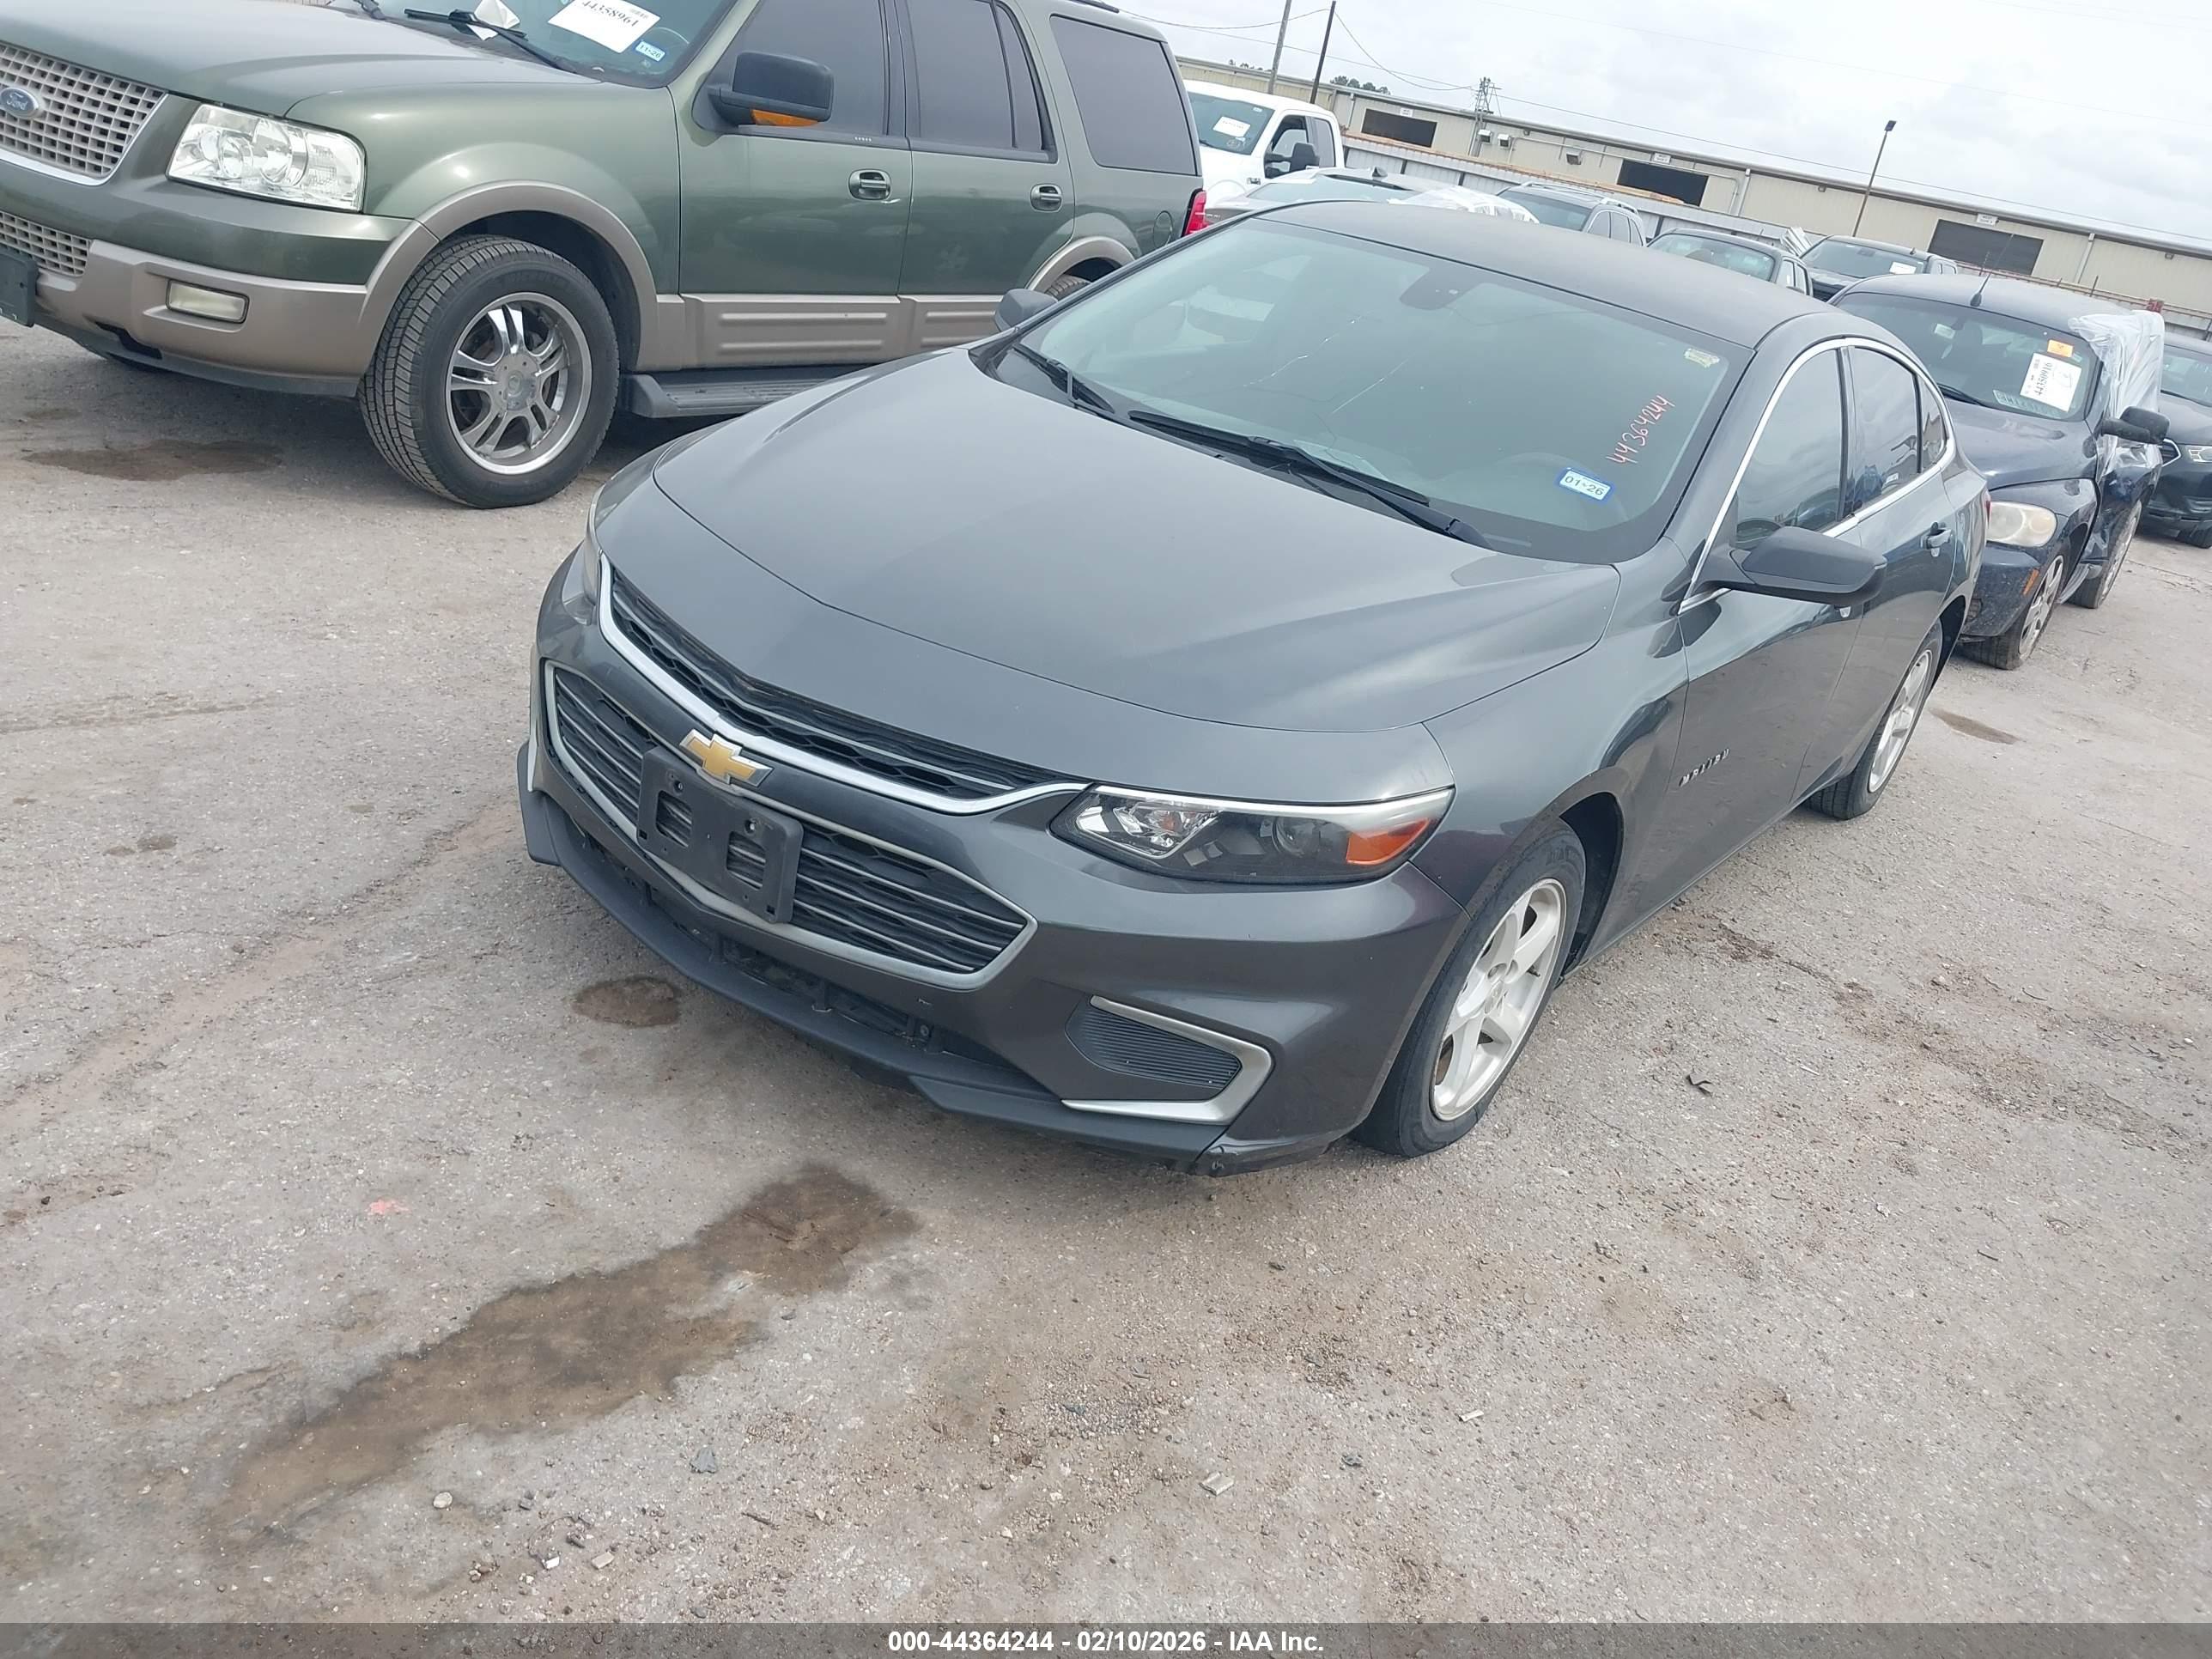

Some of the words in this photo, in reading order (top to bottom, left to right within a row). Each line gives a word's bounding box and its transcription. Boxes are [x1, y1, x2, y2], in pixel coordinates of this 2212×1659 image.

[582, 0, 640, 27] 44358961
[6, 91, 28, 111] Ford
[1605, 394, 1675, 464] 44364244
[1679, 748, 1730, 787] MALIBU
